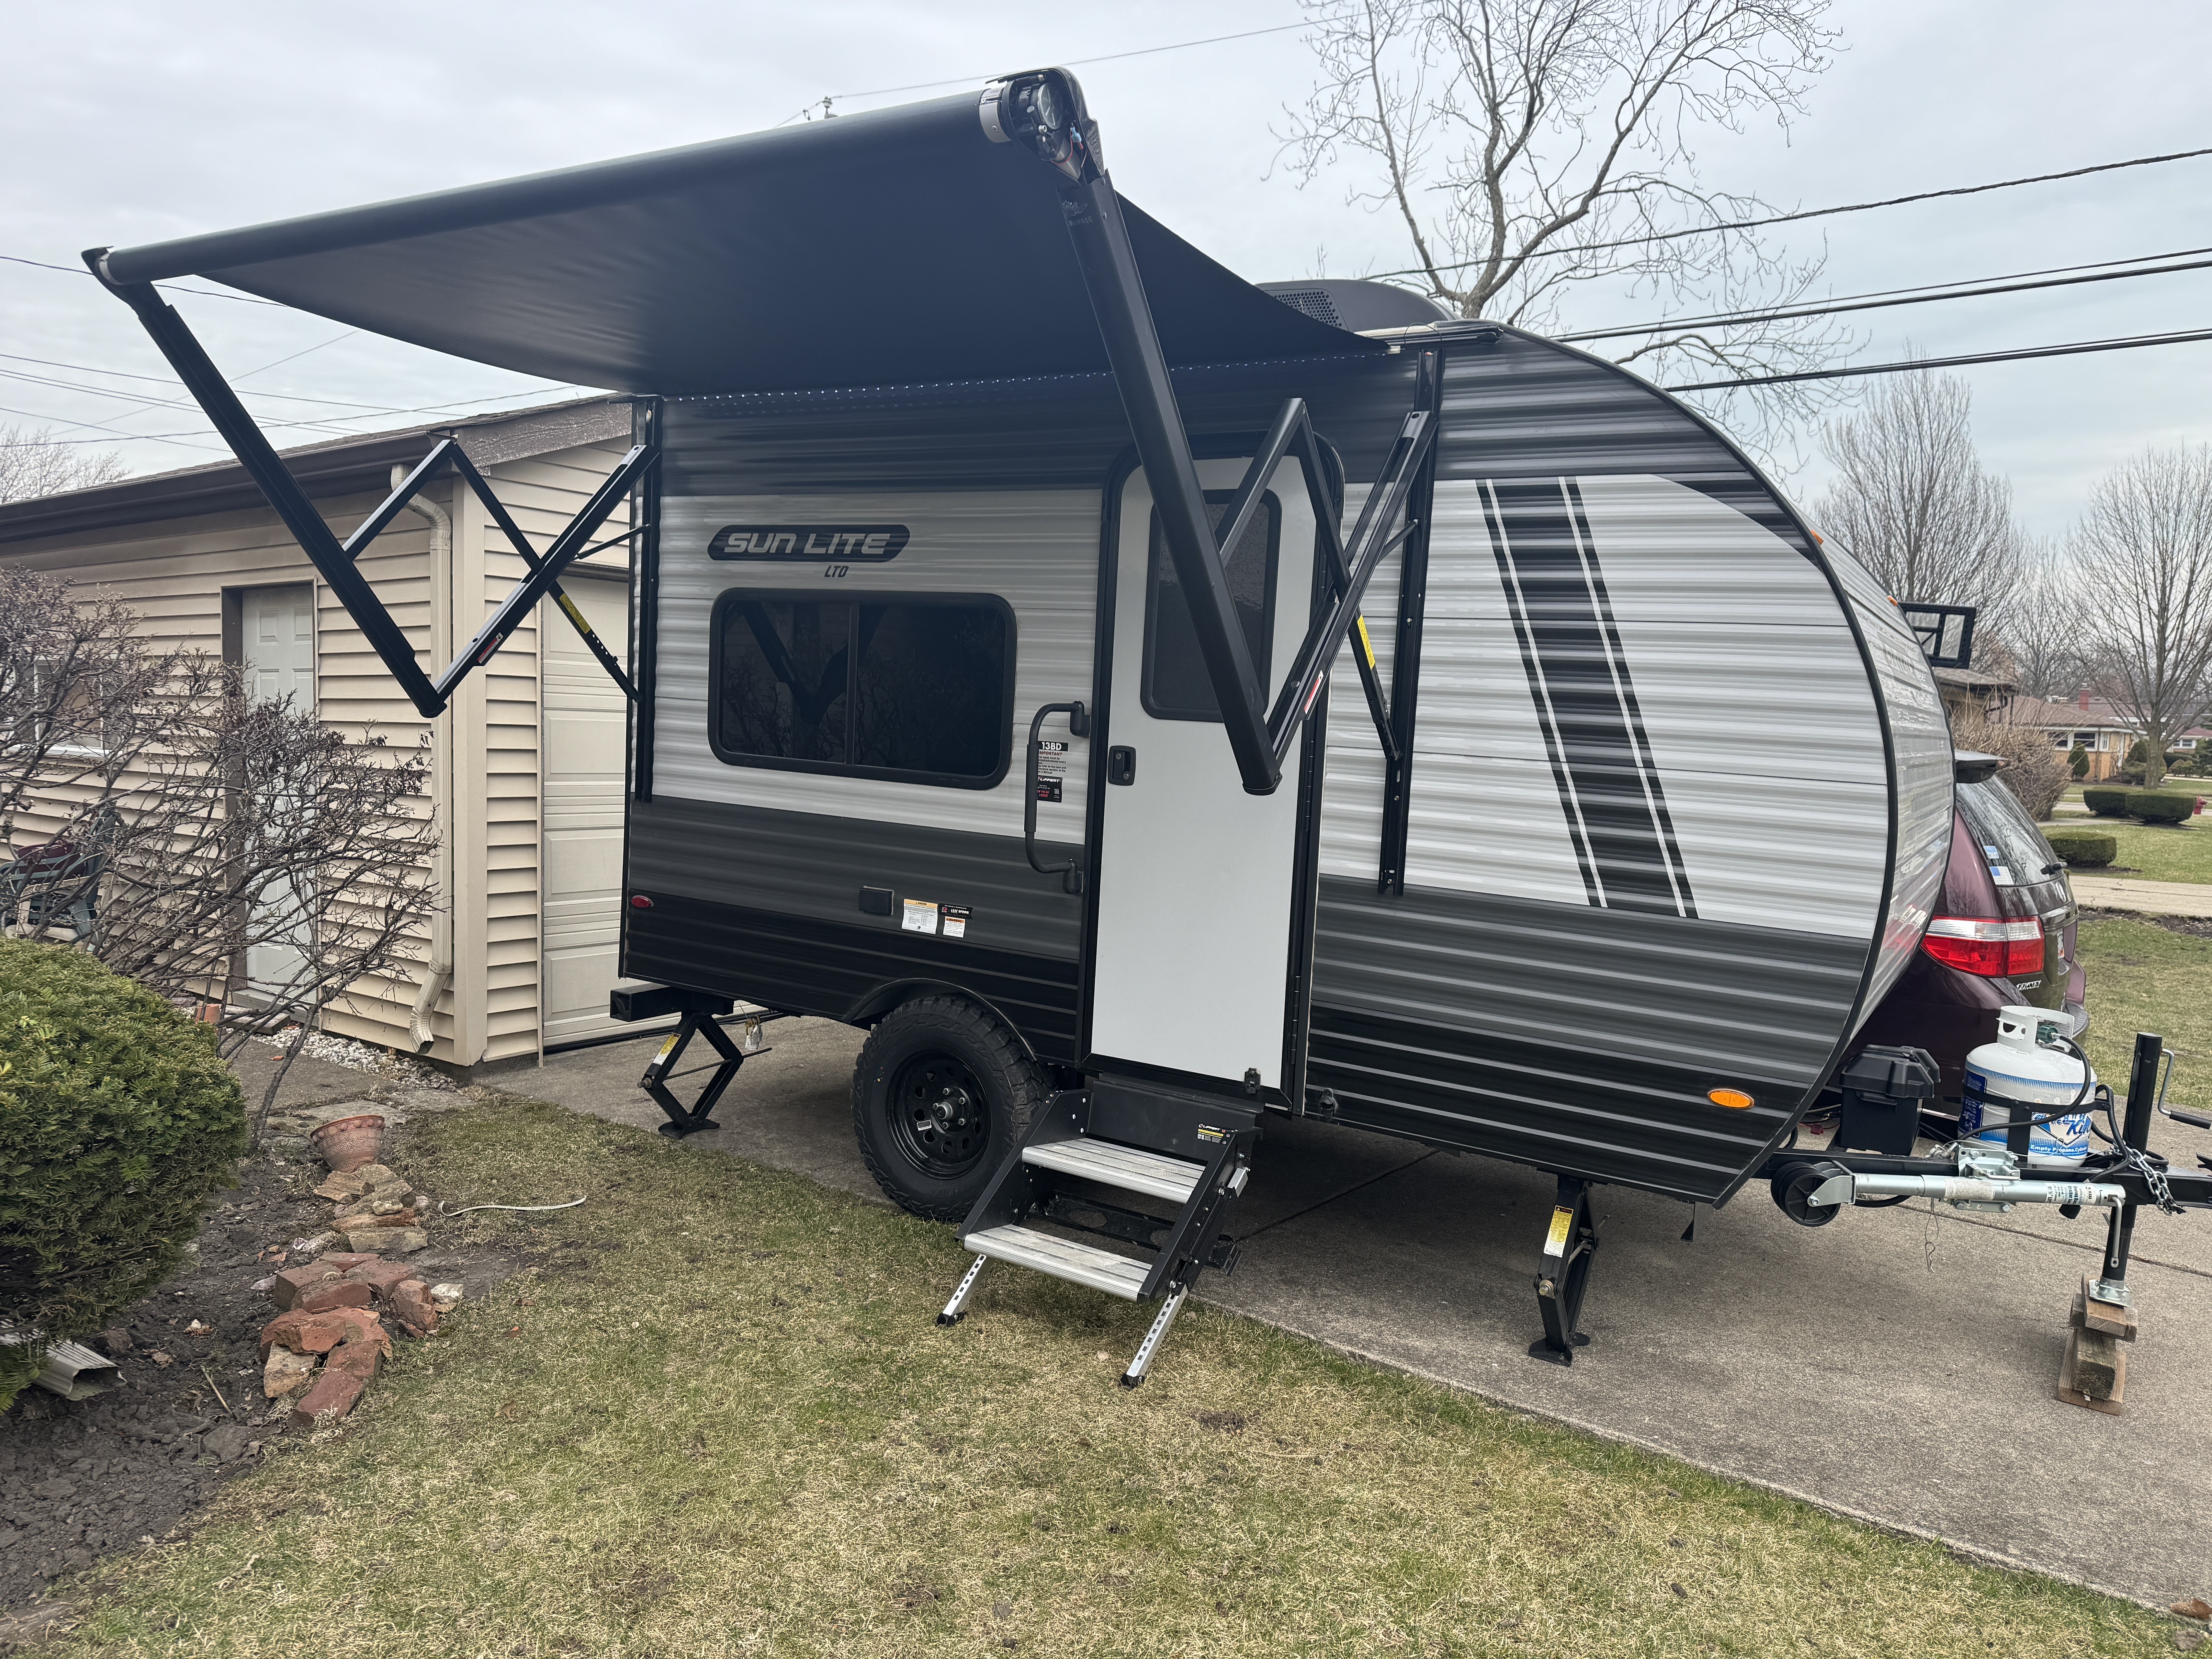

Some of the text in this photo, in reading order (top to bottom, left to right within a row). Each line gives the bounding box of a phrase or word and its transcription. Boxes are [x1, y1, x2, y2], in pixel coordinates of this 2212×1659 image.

[724, 533, 891, 554] SUN LITE
[824, 565, 849, 577] LTD
[1042, 742, 1062, 750] 13BD
